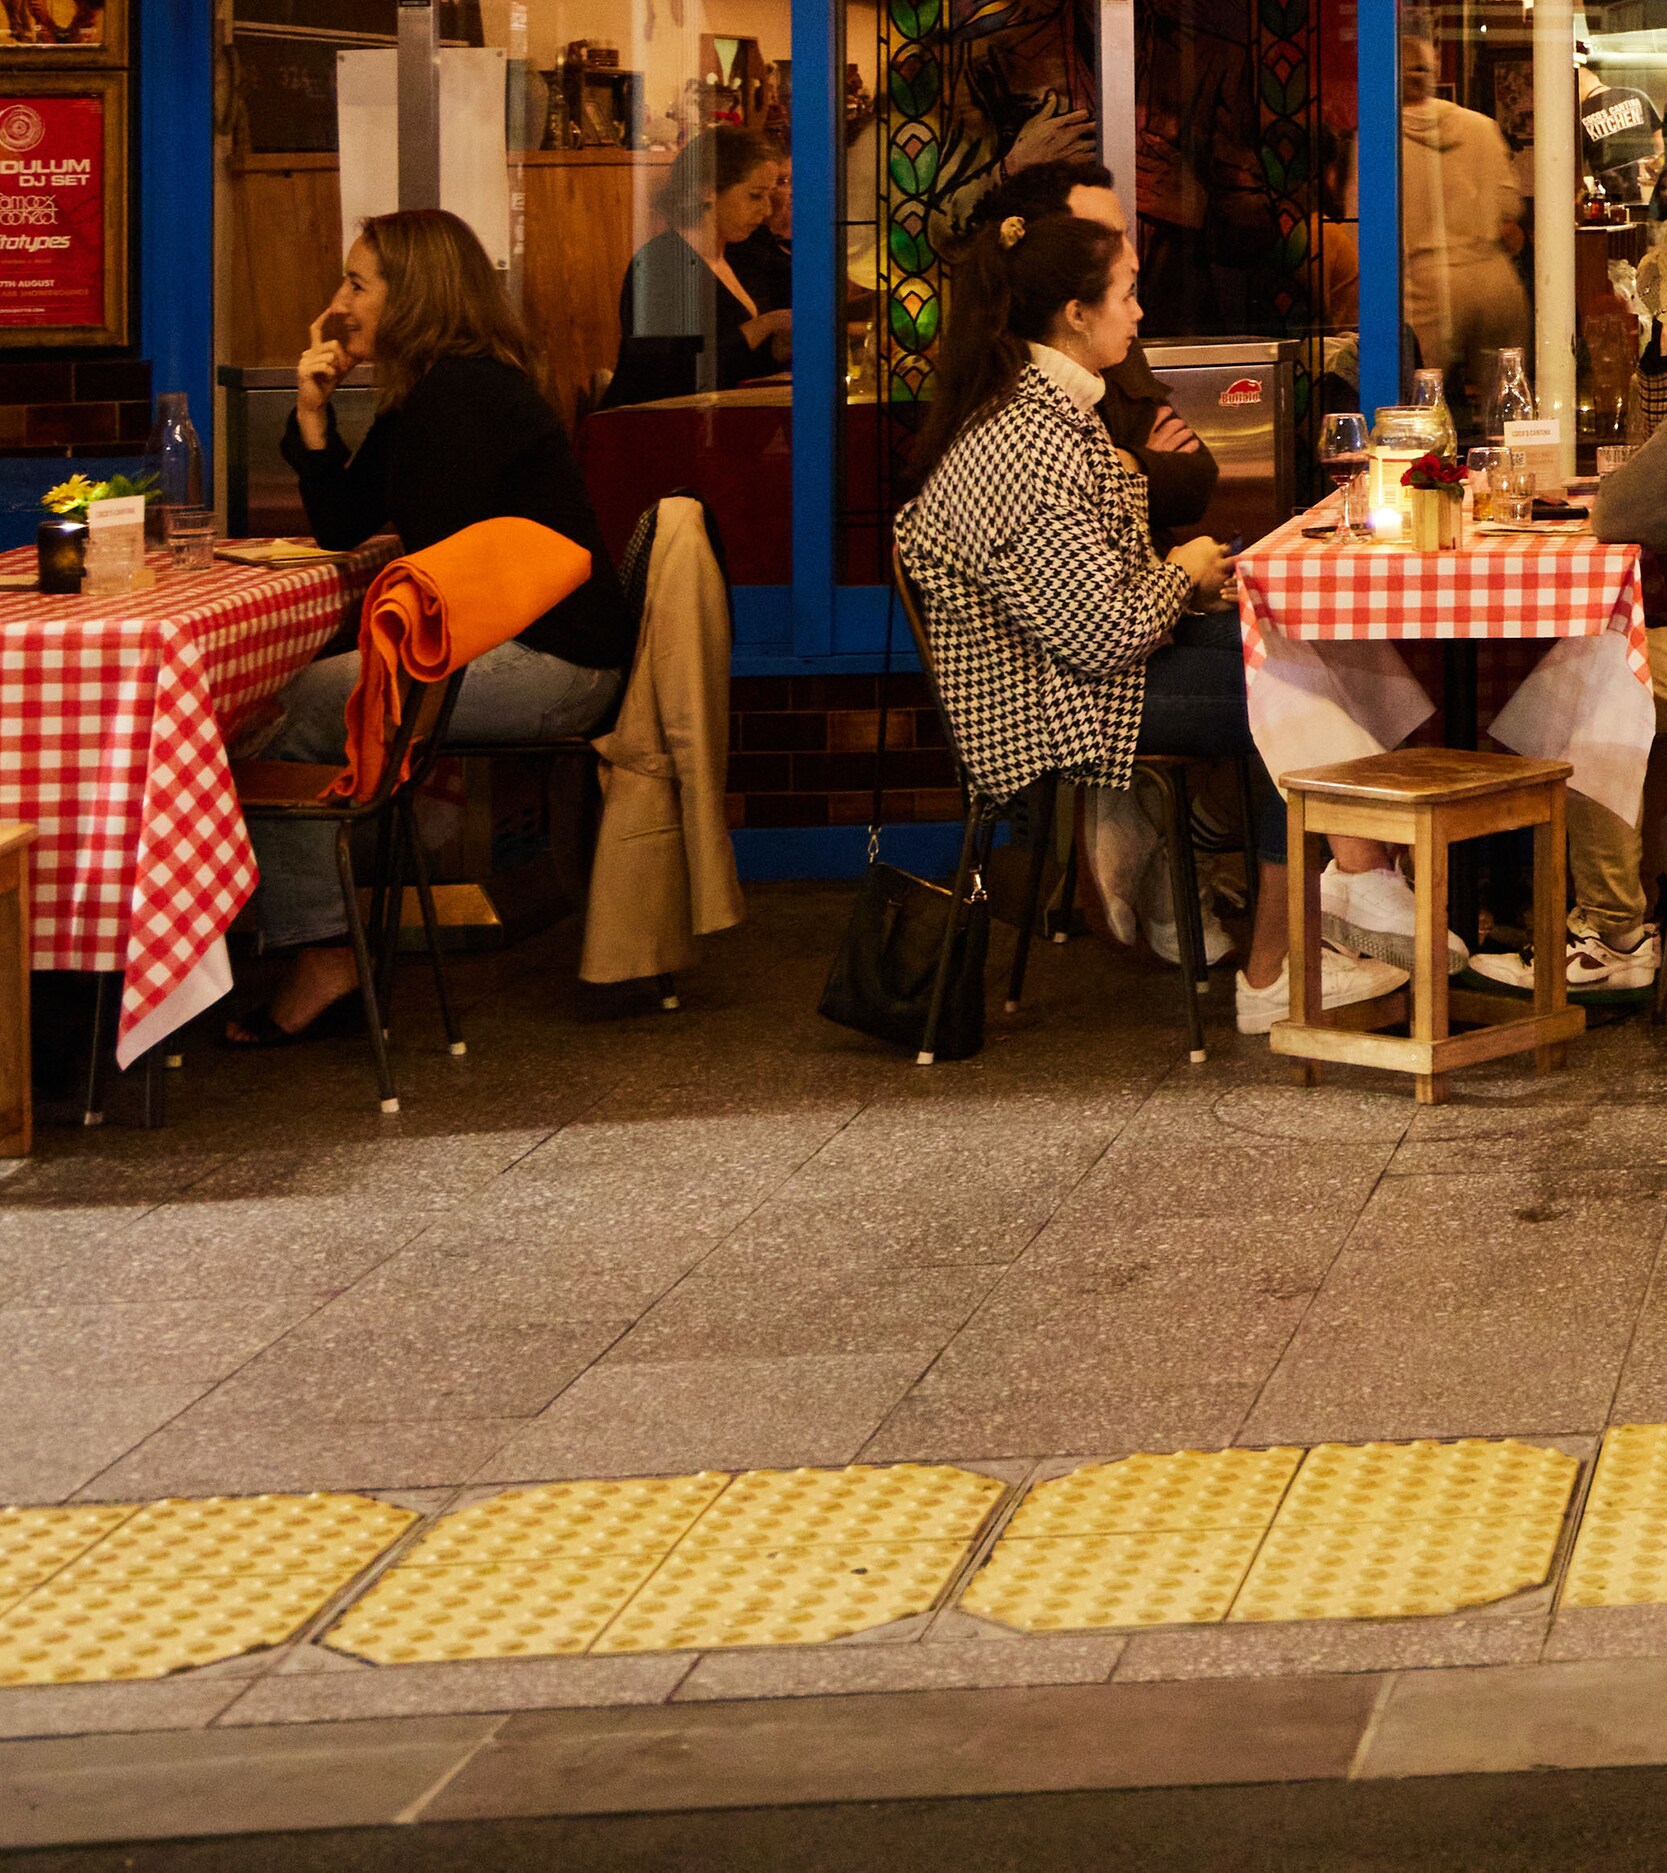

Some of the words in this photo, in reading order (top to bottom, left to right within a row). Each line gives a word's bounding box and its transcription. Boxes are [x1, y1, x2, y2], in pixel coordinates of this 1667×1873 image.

[1587, 108, 1644, 140] KITCHEN
[19, 176, 46, 187] DJ
[51, 175, 91, 186] SET
[18, 280, 55, 288] AUGUST
